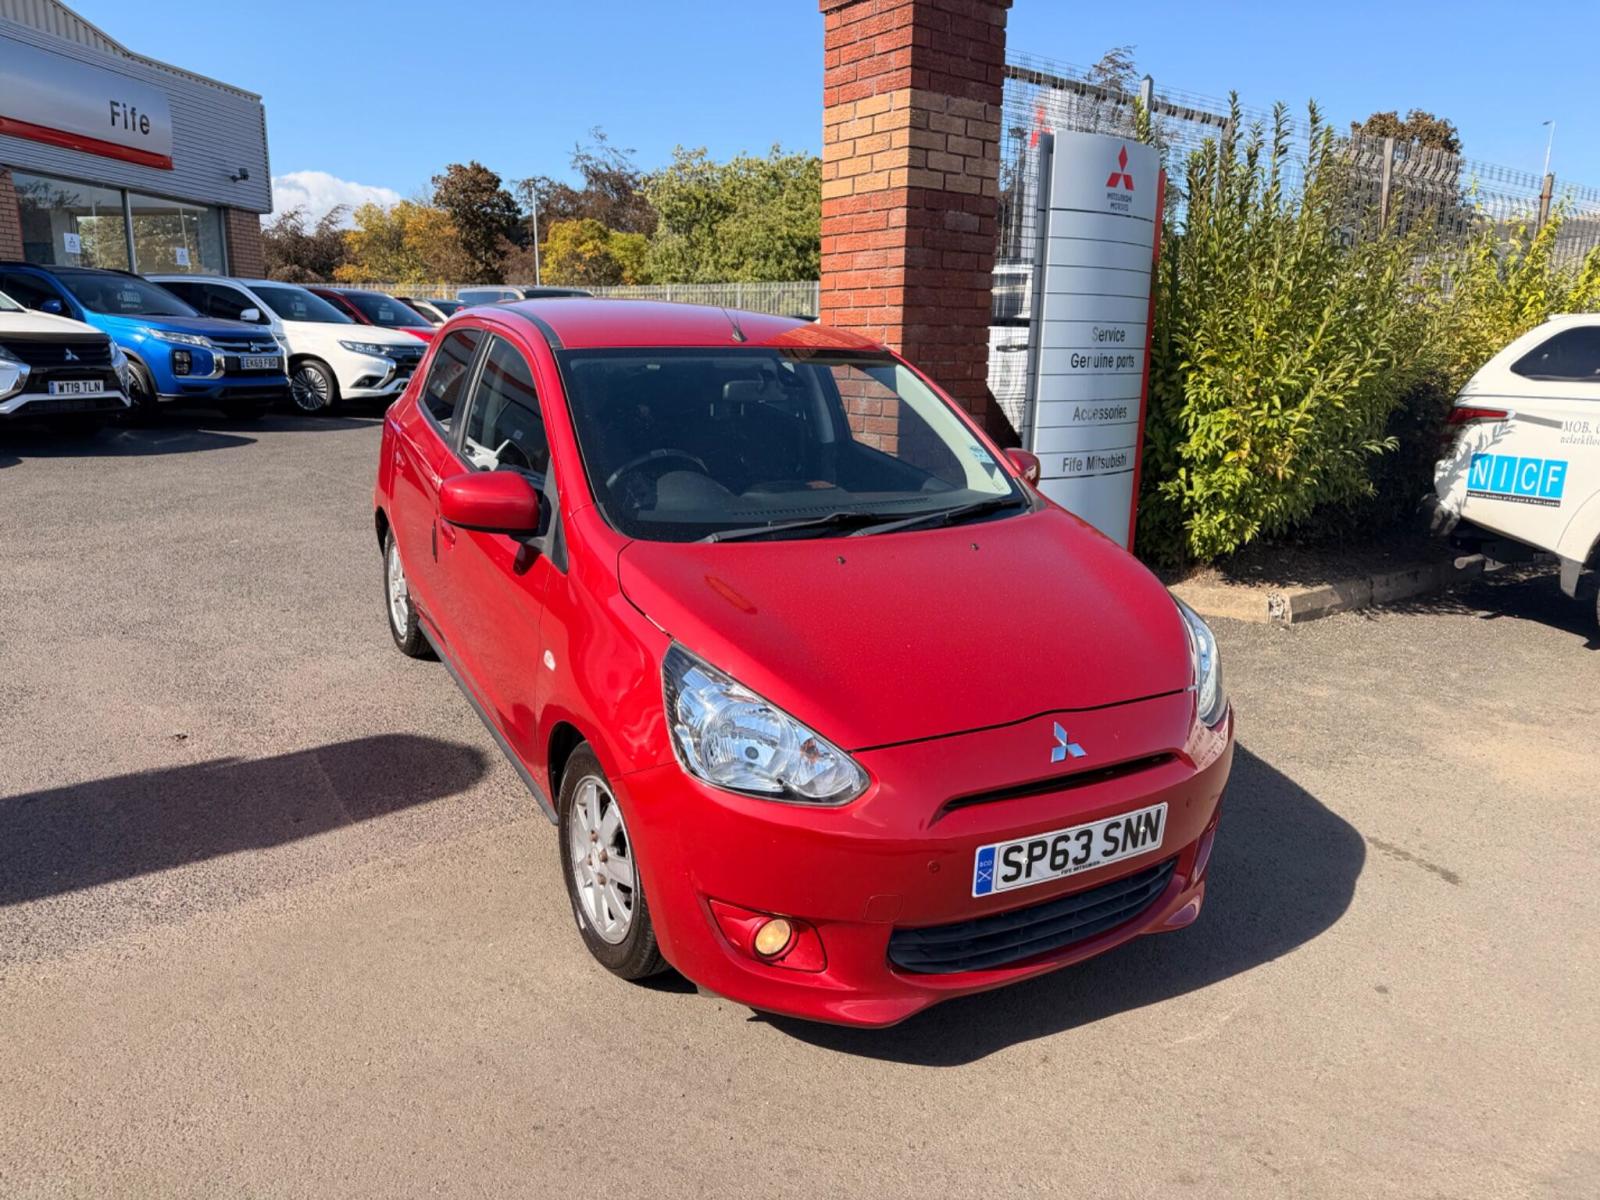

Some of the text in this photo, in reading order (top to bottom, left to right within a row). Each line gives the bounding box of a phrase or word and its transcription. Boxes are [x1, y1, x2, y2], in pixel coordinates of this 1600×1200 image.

[110, 100, 150, 135] Fife
[1092, 326, 1126, 342] Service
[1116, 354, 1135, 371] parts
[58, 381, 101, 393] WT19 TLN
[1072, 404, 1128, 421] Accessories
[1062, 452, 1127, 473] Fife Mitsubishi
[1472, 458, 1562, 494] NICF
[1002, 809, 1162, 883] SP63 SNN
